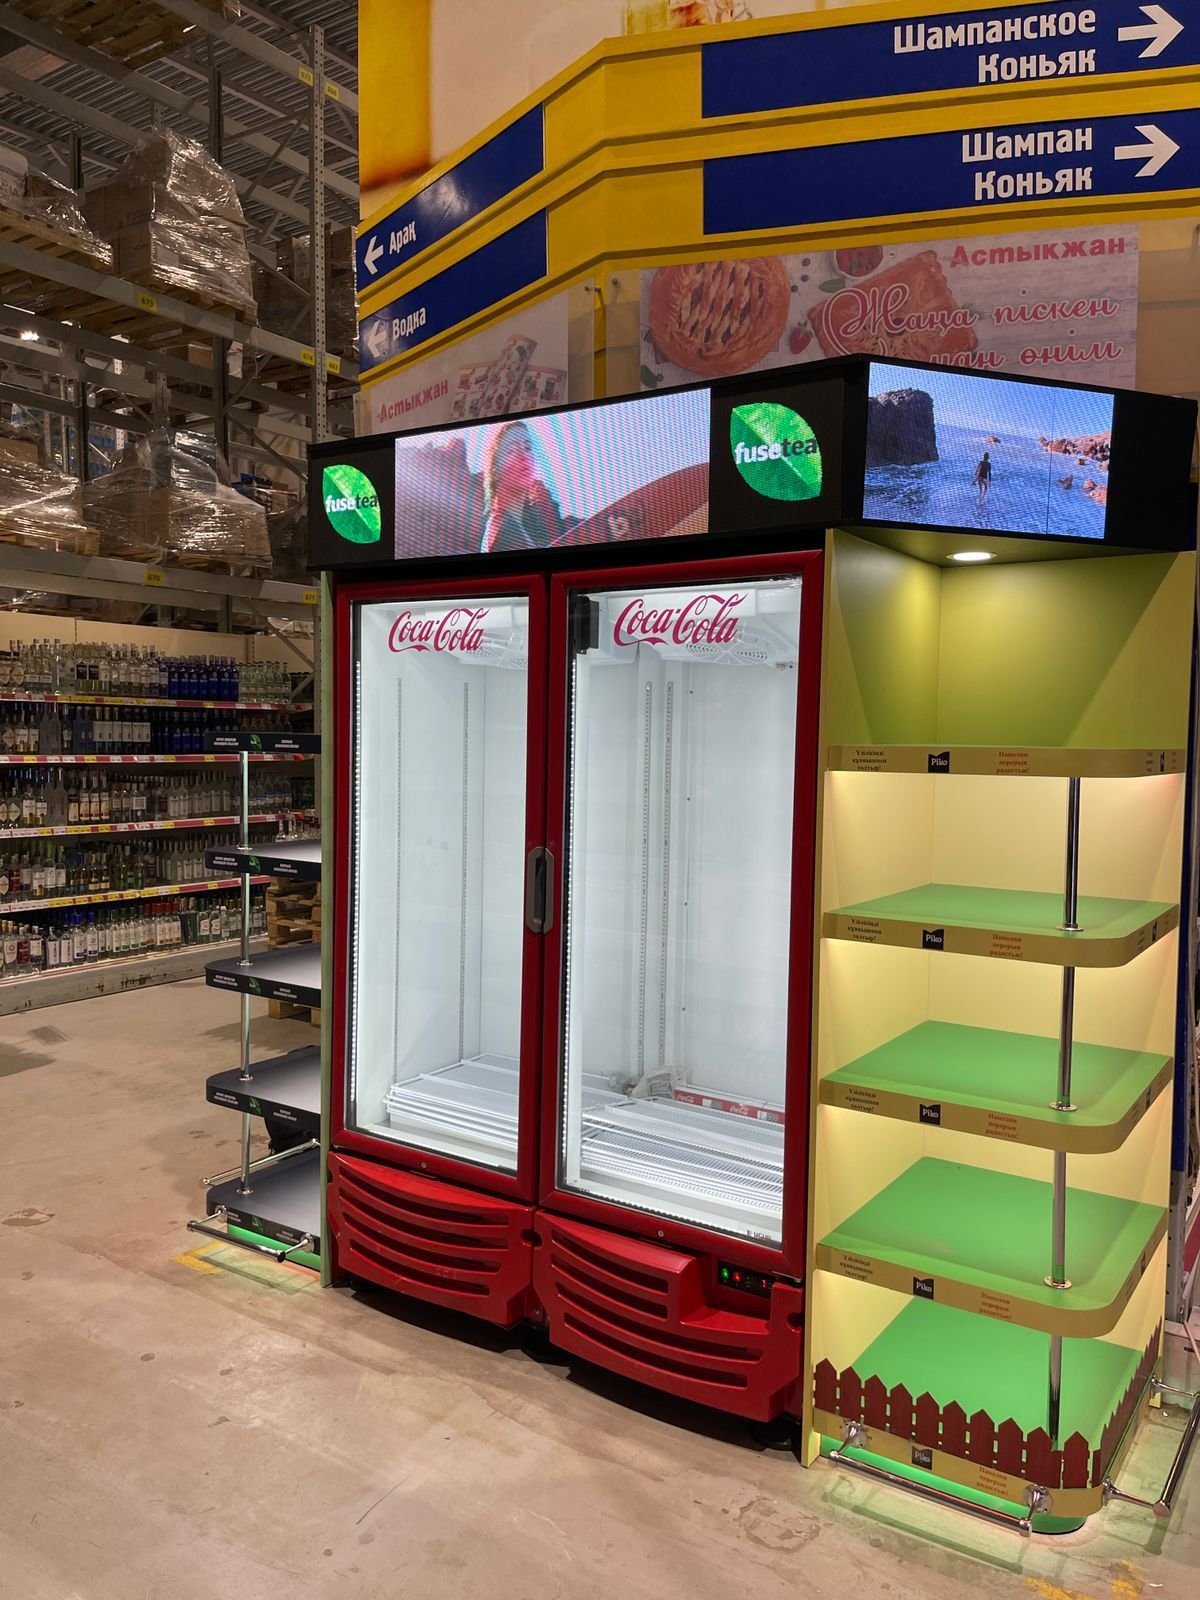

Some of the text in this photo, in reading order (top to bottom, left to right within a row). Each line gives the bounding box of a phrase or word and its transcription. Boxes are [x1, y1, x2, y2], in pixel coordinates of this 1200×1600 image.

[893, 9, 1097, 54] Шампанское
[978, 48, 1097, 84] Коньяк
[962, 127, 1094, 164] Шампан
[974, 166, 1093, 201] Коньяк
[389, 220, 417, 255] Арақ
[949, 236, 1125, 269] Астықжан
[392, 307, 426, 341] Водка
[821, 283, 1120, 357] Жаңа піскен
[388, 607, 490, 653] Coca-Cola
[613, 592, 749, 647] Coca-Cola
[931, 758, 948, 766] Piko
[925, 933, 942, 943] Piko
[922, 1108, 939, 1118] Piko
[916, 1281, 932, 1293] Piko
[914, 1450, 931, 1463] Piko
